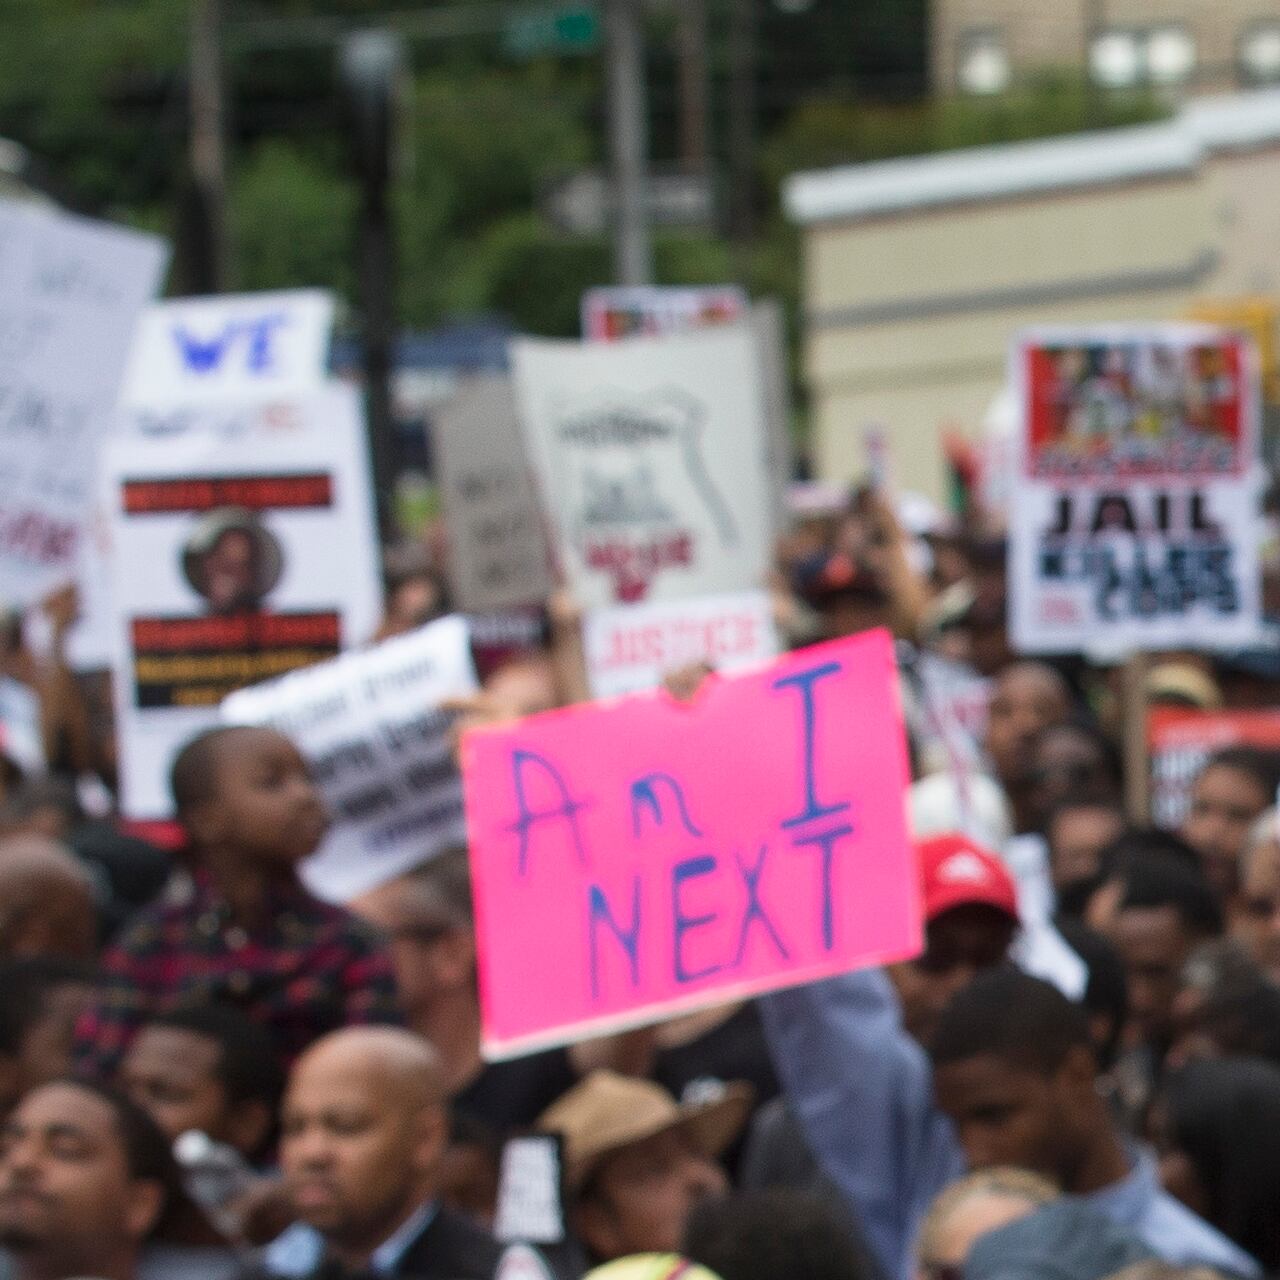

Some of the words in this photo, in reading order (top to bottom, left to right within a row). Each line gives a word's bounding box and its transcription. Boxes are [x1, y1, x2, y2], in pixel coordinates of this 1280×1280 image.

[1045, 490, 1222, 537] JAIL
[772, 662, 852, 829] I
[588, 824, 855, 1000] NEXT
